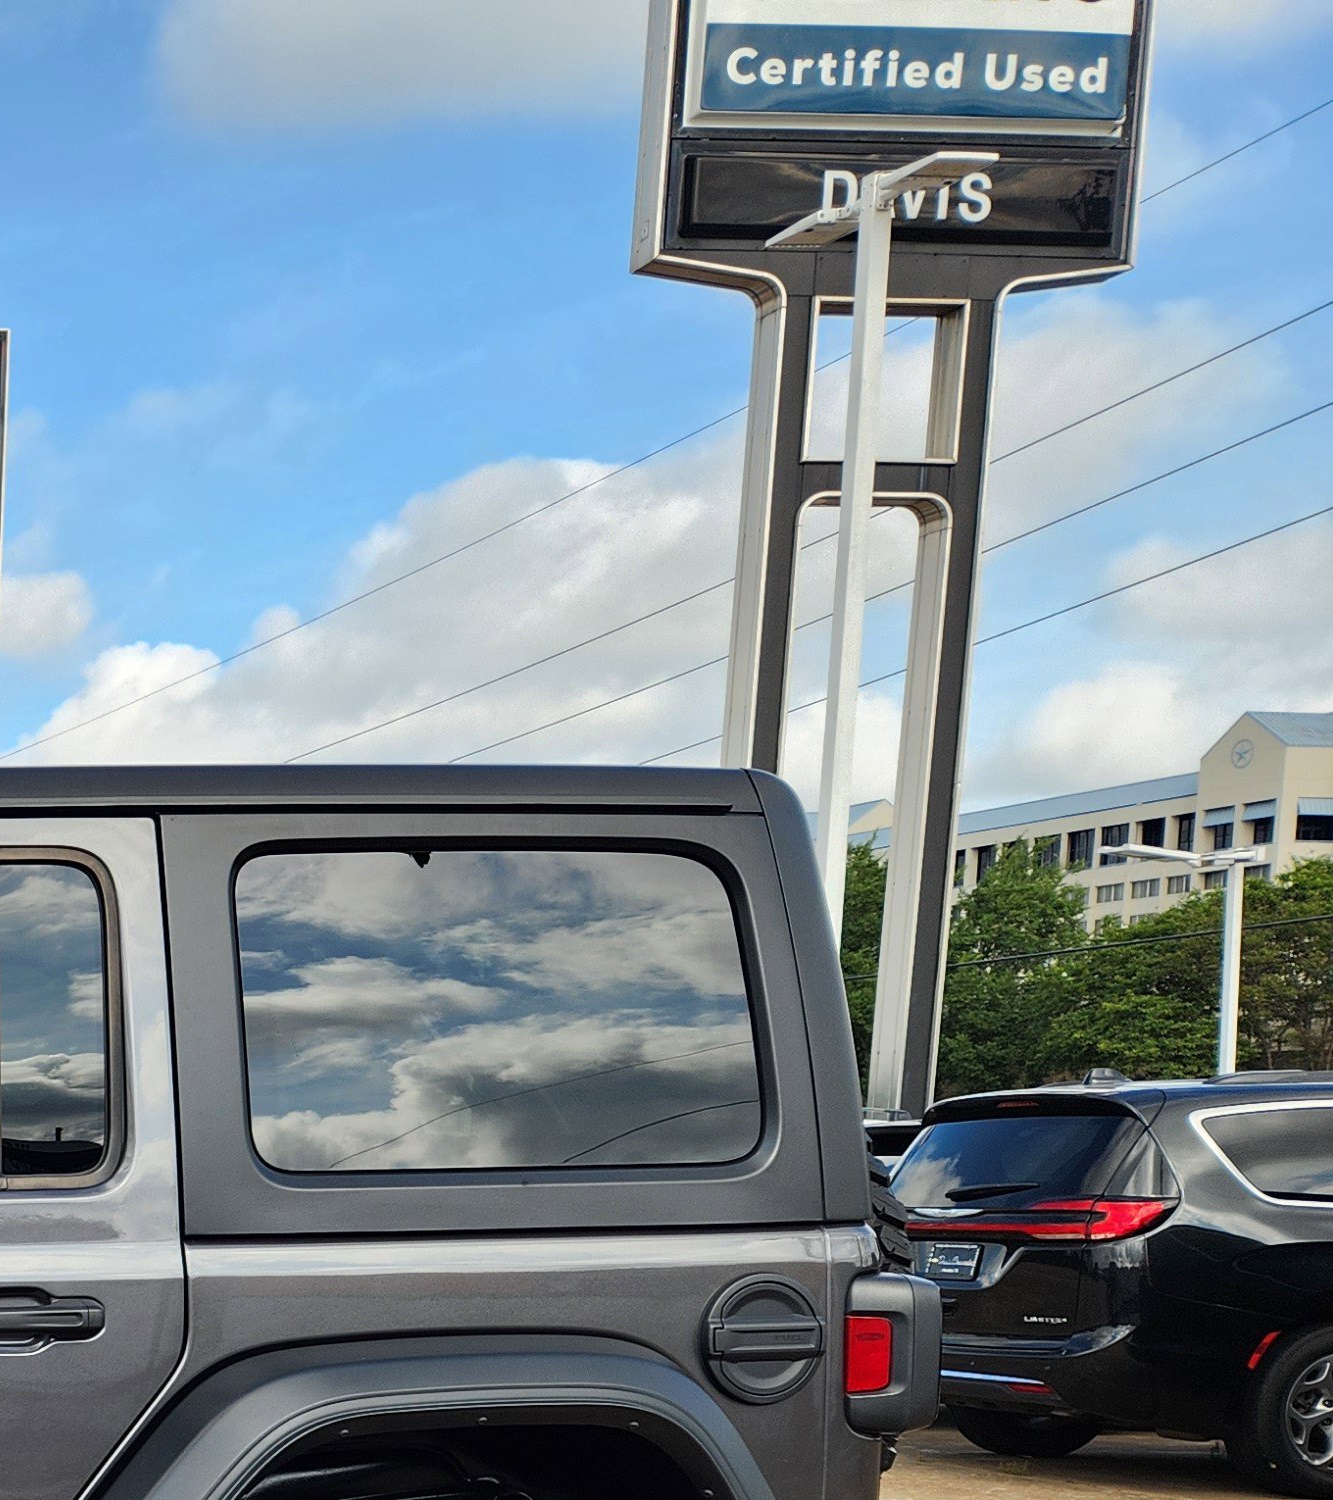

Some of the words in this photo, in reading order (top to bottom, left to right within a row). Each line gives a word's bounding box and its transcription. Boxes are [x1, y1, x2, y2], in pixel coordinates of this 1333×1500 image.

[726, 46, 964, 90] Certified
[984, 53, 1109, 94] Used
[822, 169, 993, 223] DVIS
